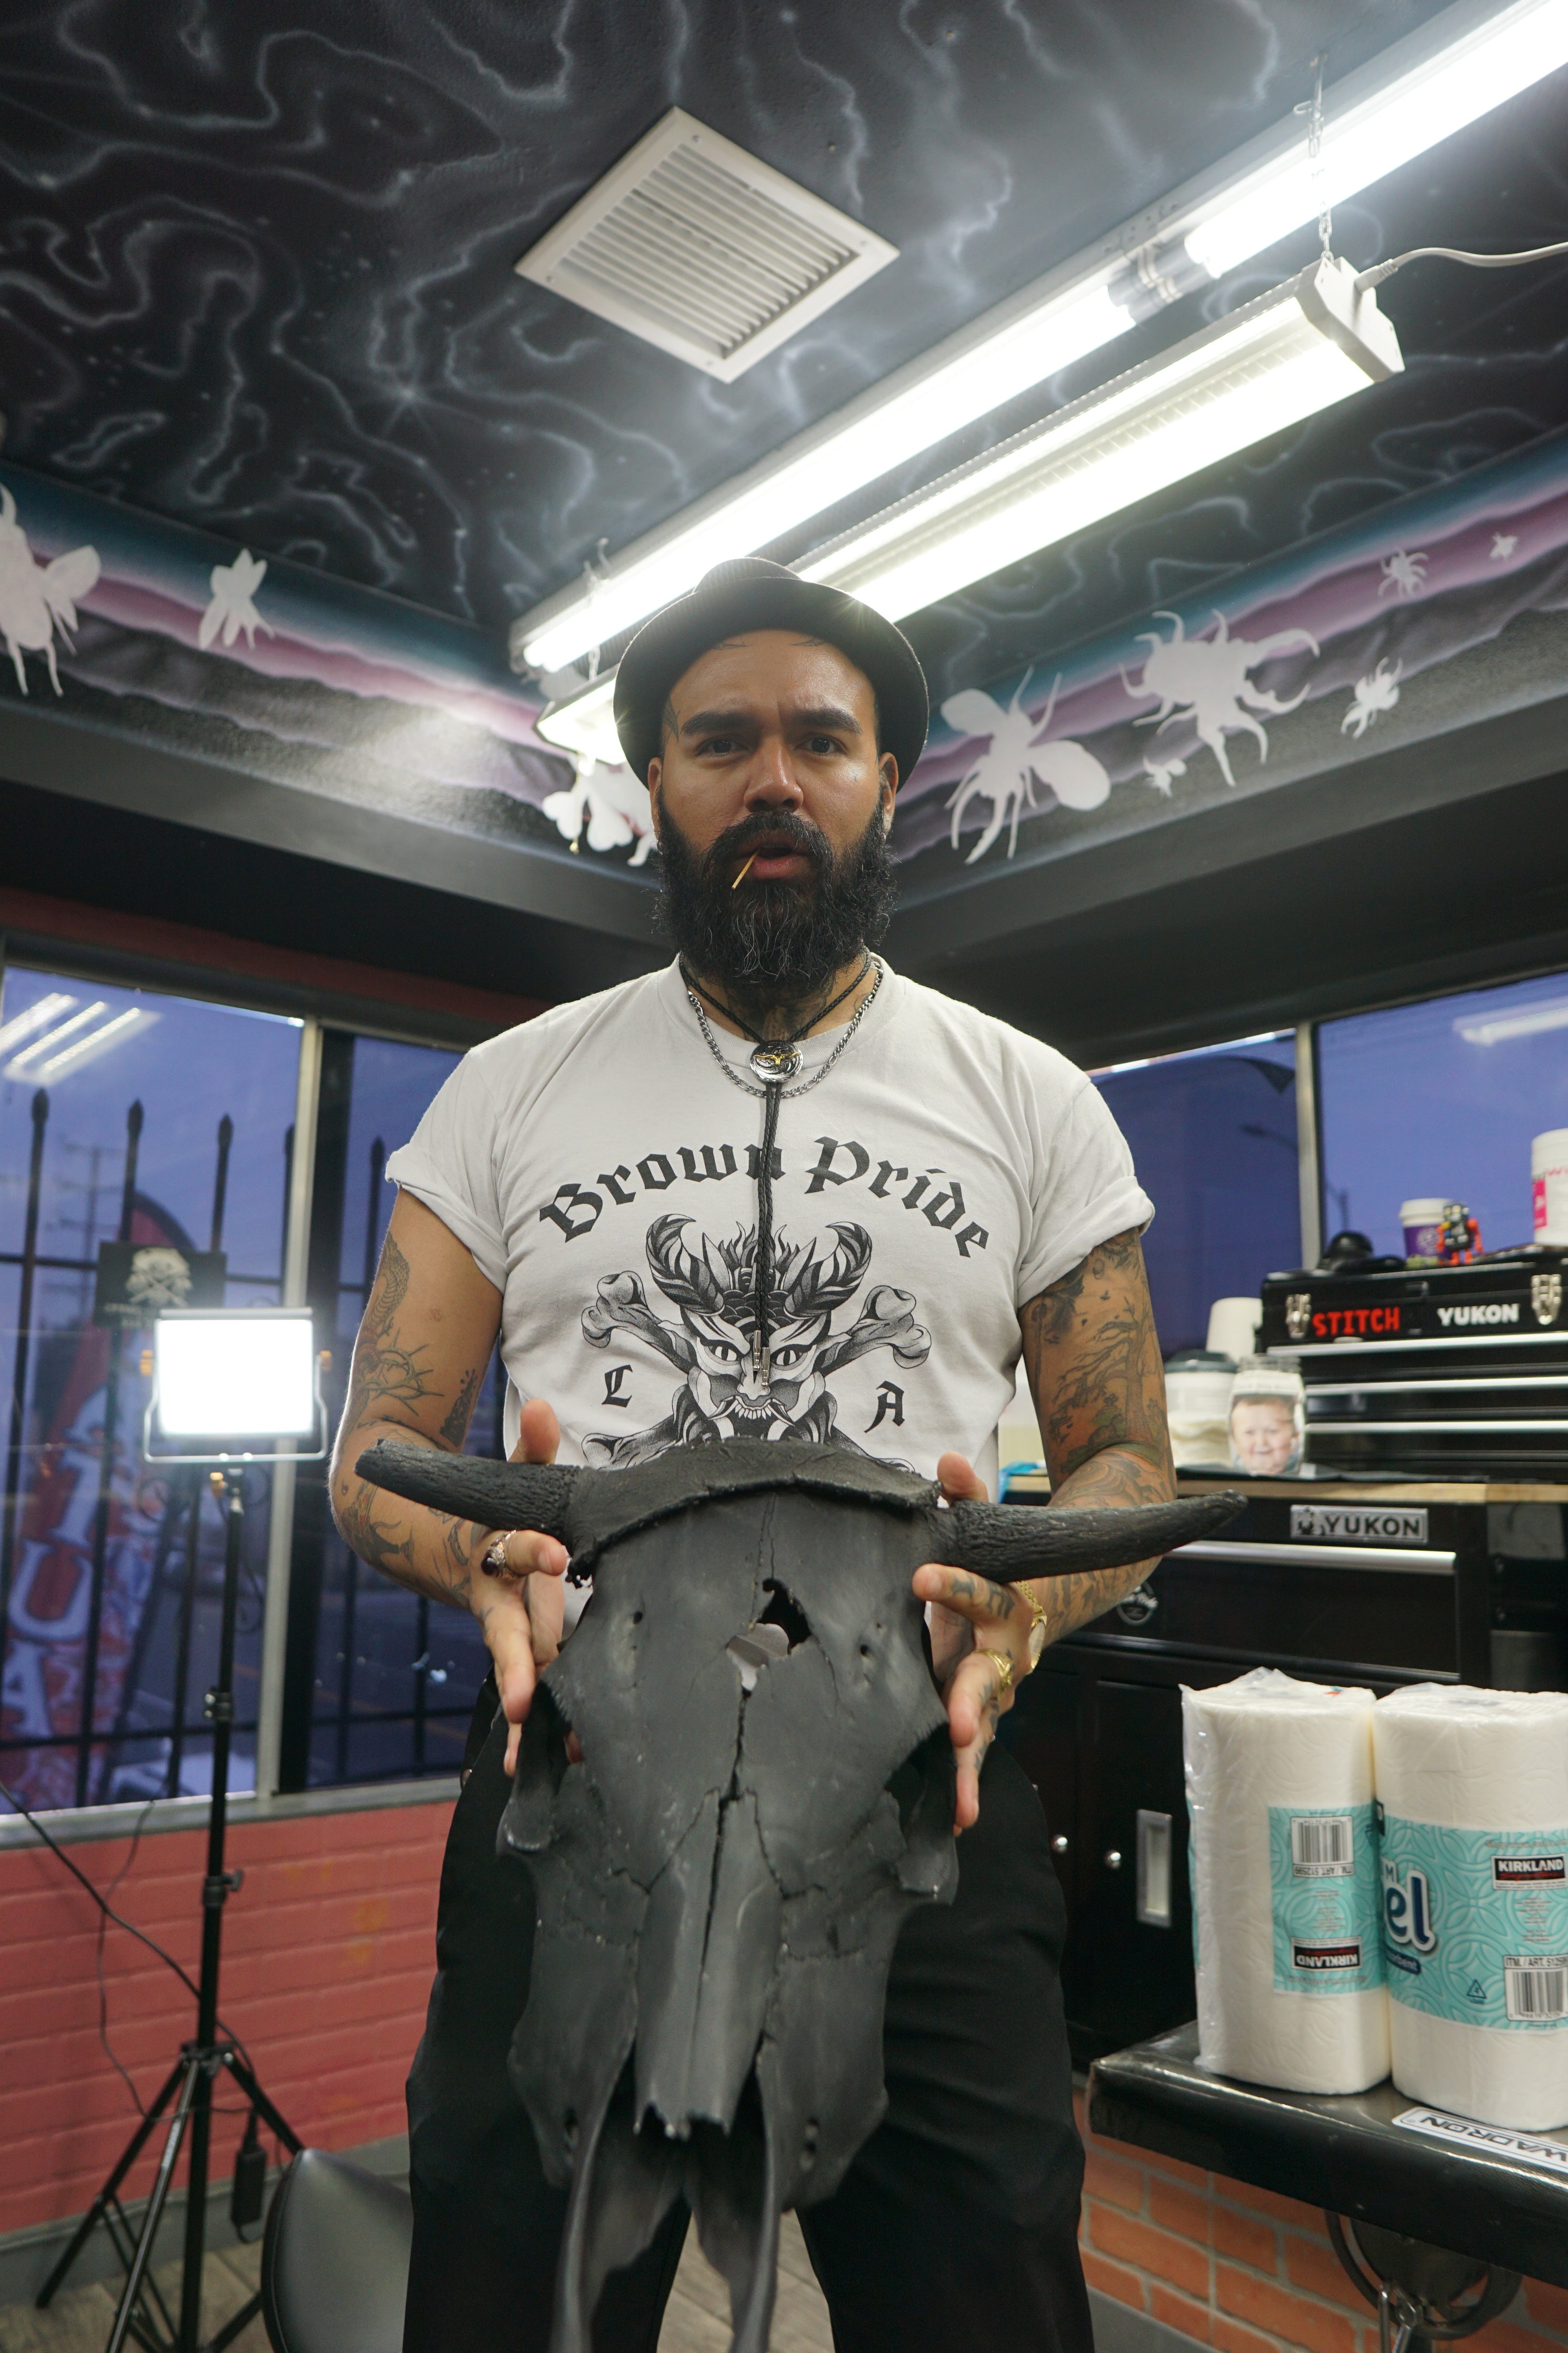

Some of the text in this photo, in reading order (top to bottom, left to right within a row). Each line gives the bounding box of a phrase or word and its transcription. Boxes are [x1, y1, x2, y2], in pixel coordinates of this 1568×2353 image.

[540, 1136, 989, 1258] Brown Pride
[1313, 1306, 1401, 1337] STITCH
[1437, 1302, 1520, 1327] YUKON
[602, 1364, 906, 1433] L A
[1326, 1515, 1420, 1536] YUKON
[1498, 1858, 1564, 1872] KIRKLAND
[1296, 1953, 1358, 1967] KIRKLAND
